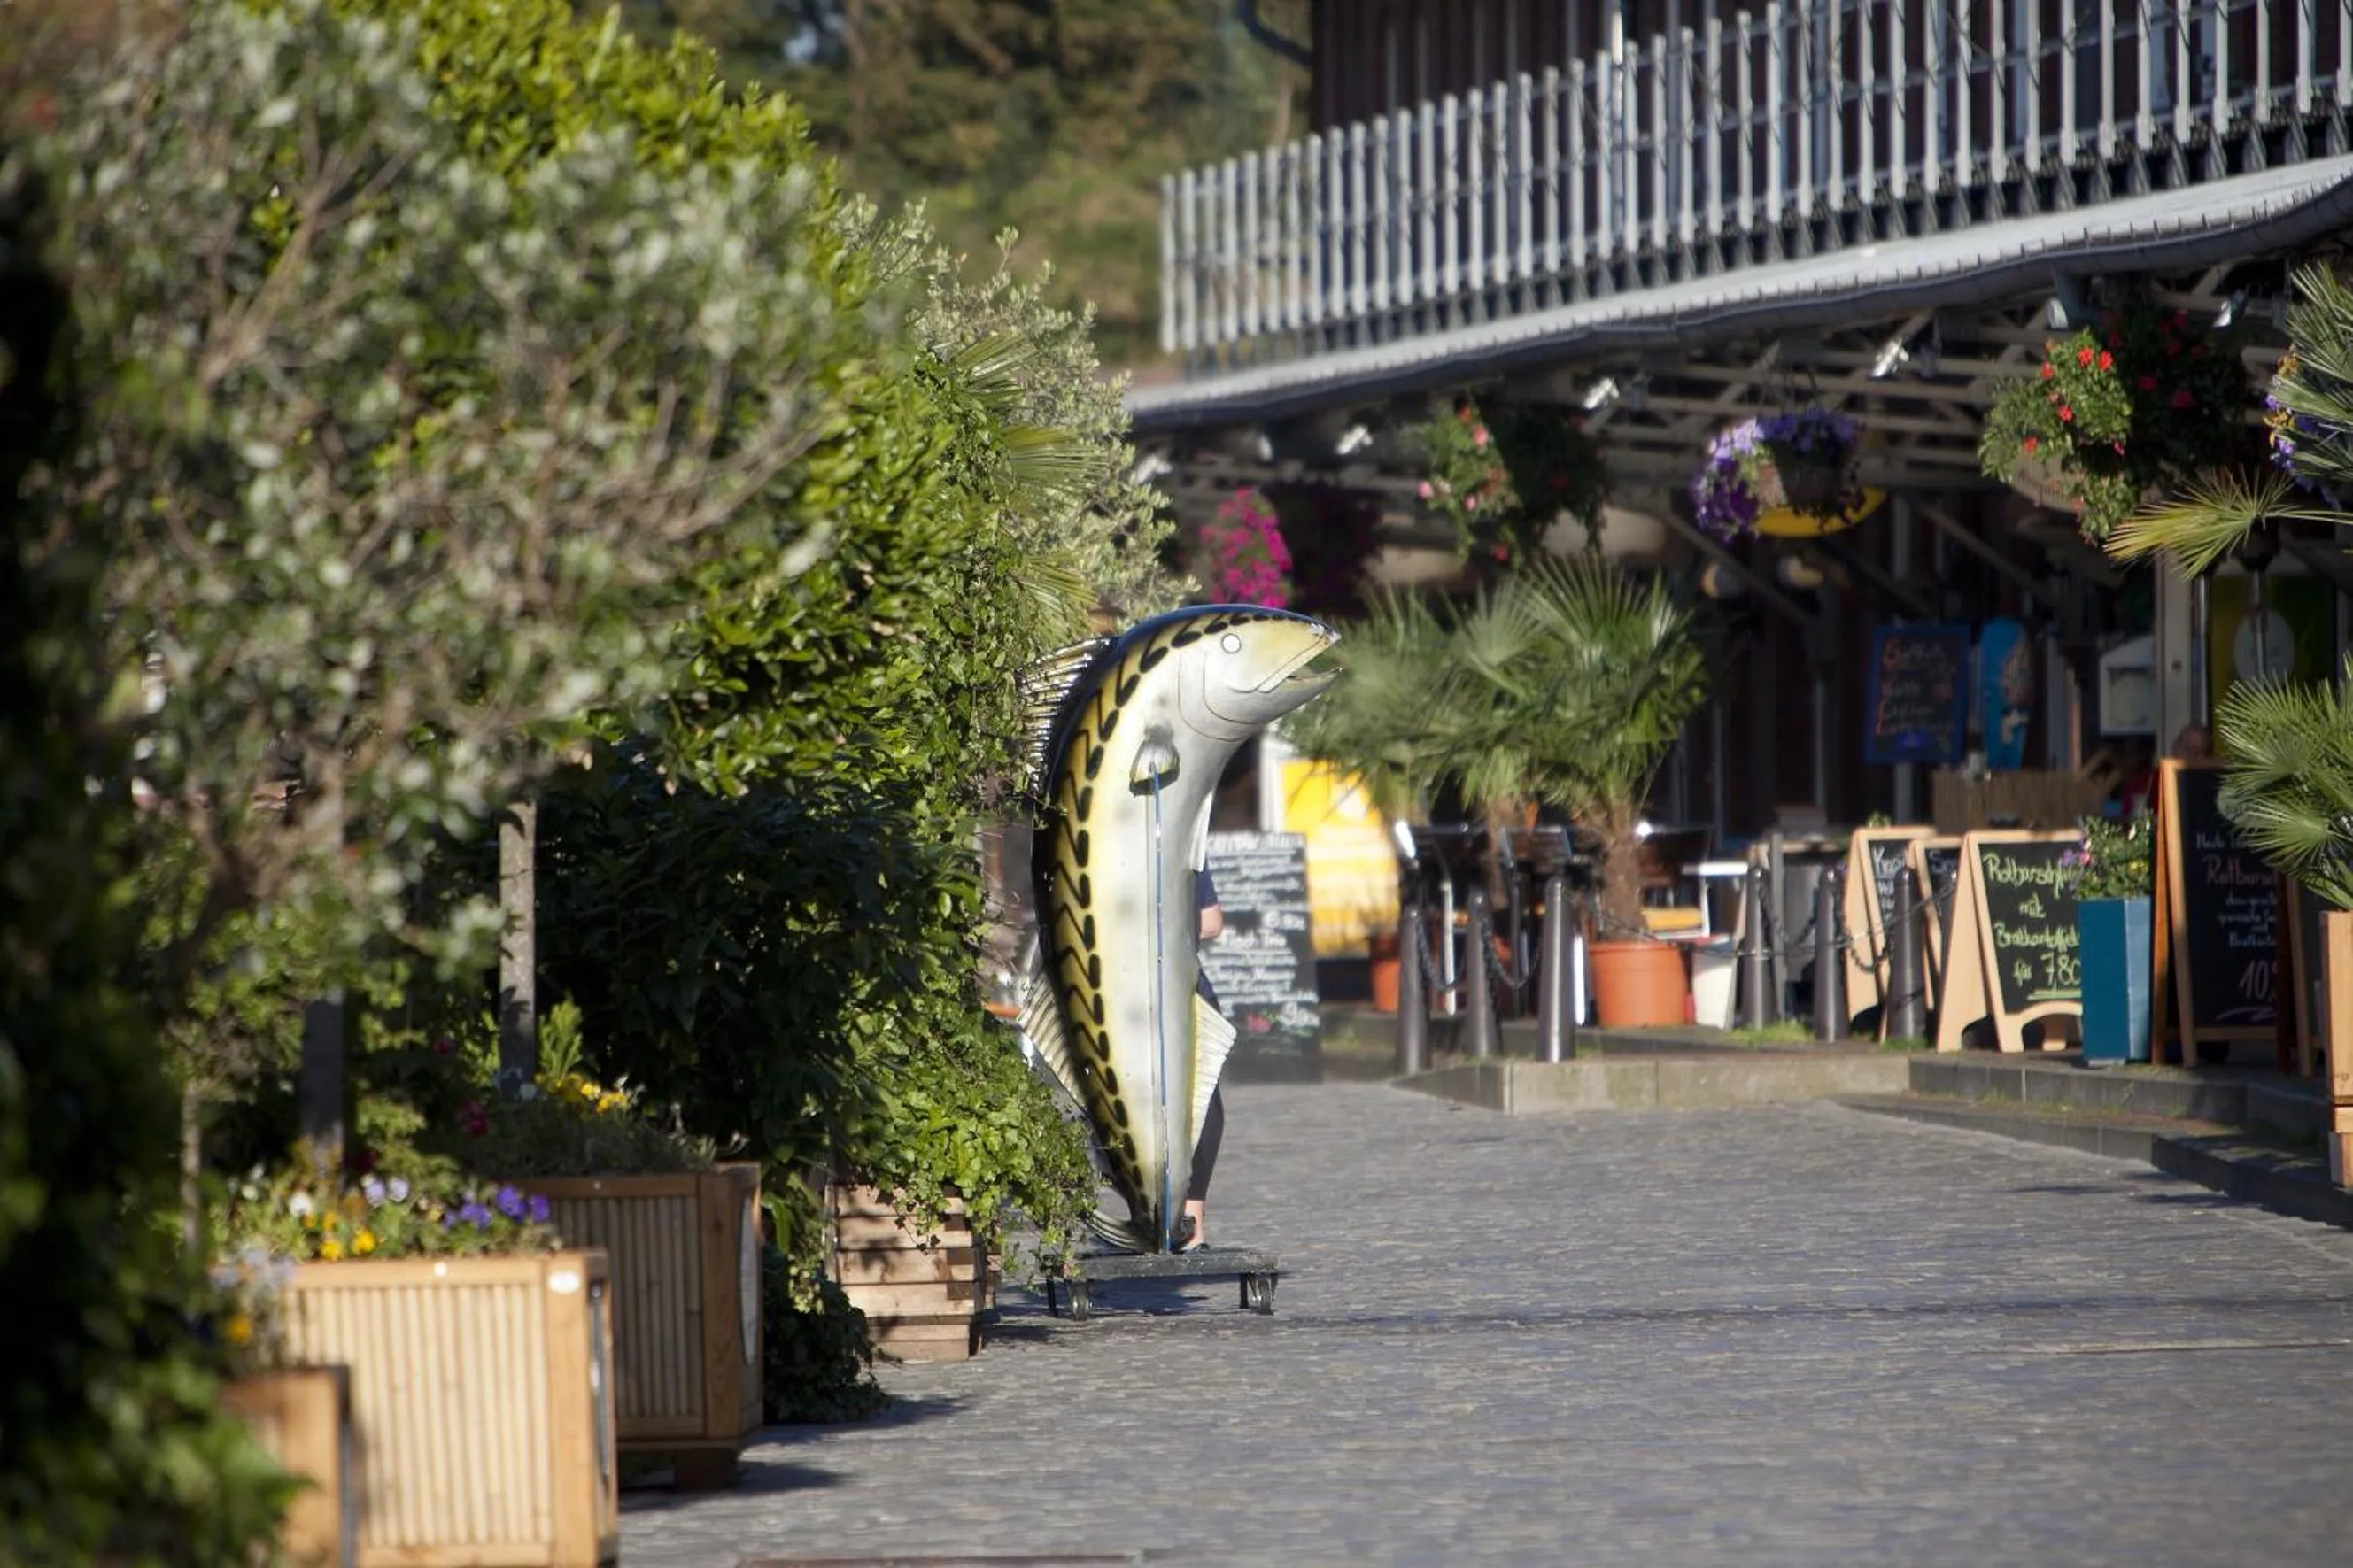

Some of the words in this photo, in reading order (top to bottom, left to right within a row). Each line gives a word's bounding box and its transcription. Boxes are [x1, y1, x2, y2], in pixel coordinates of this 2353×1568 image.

[2019, 892, 2047, 918] mit
[1993, 922, 2080, 953] Bratkartoffel
[2013, 958, 2032, 988] für
